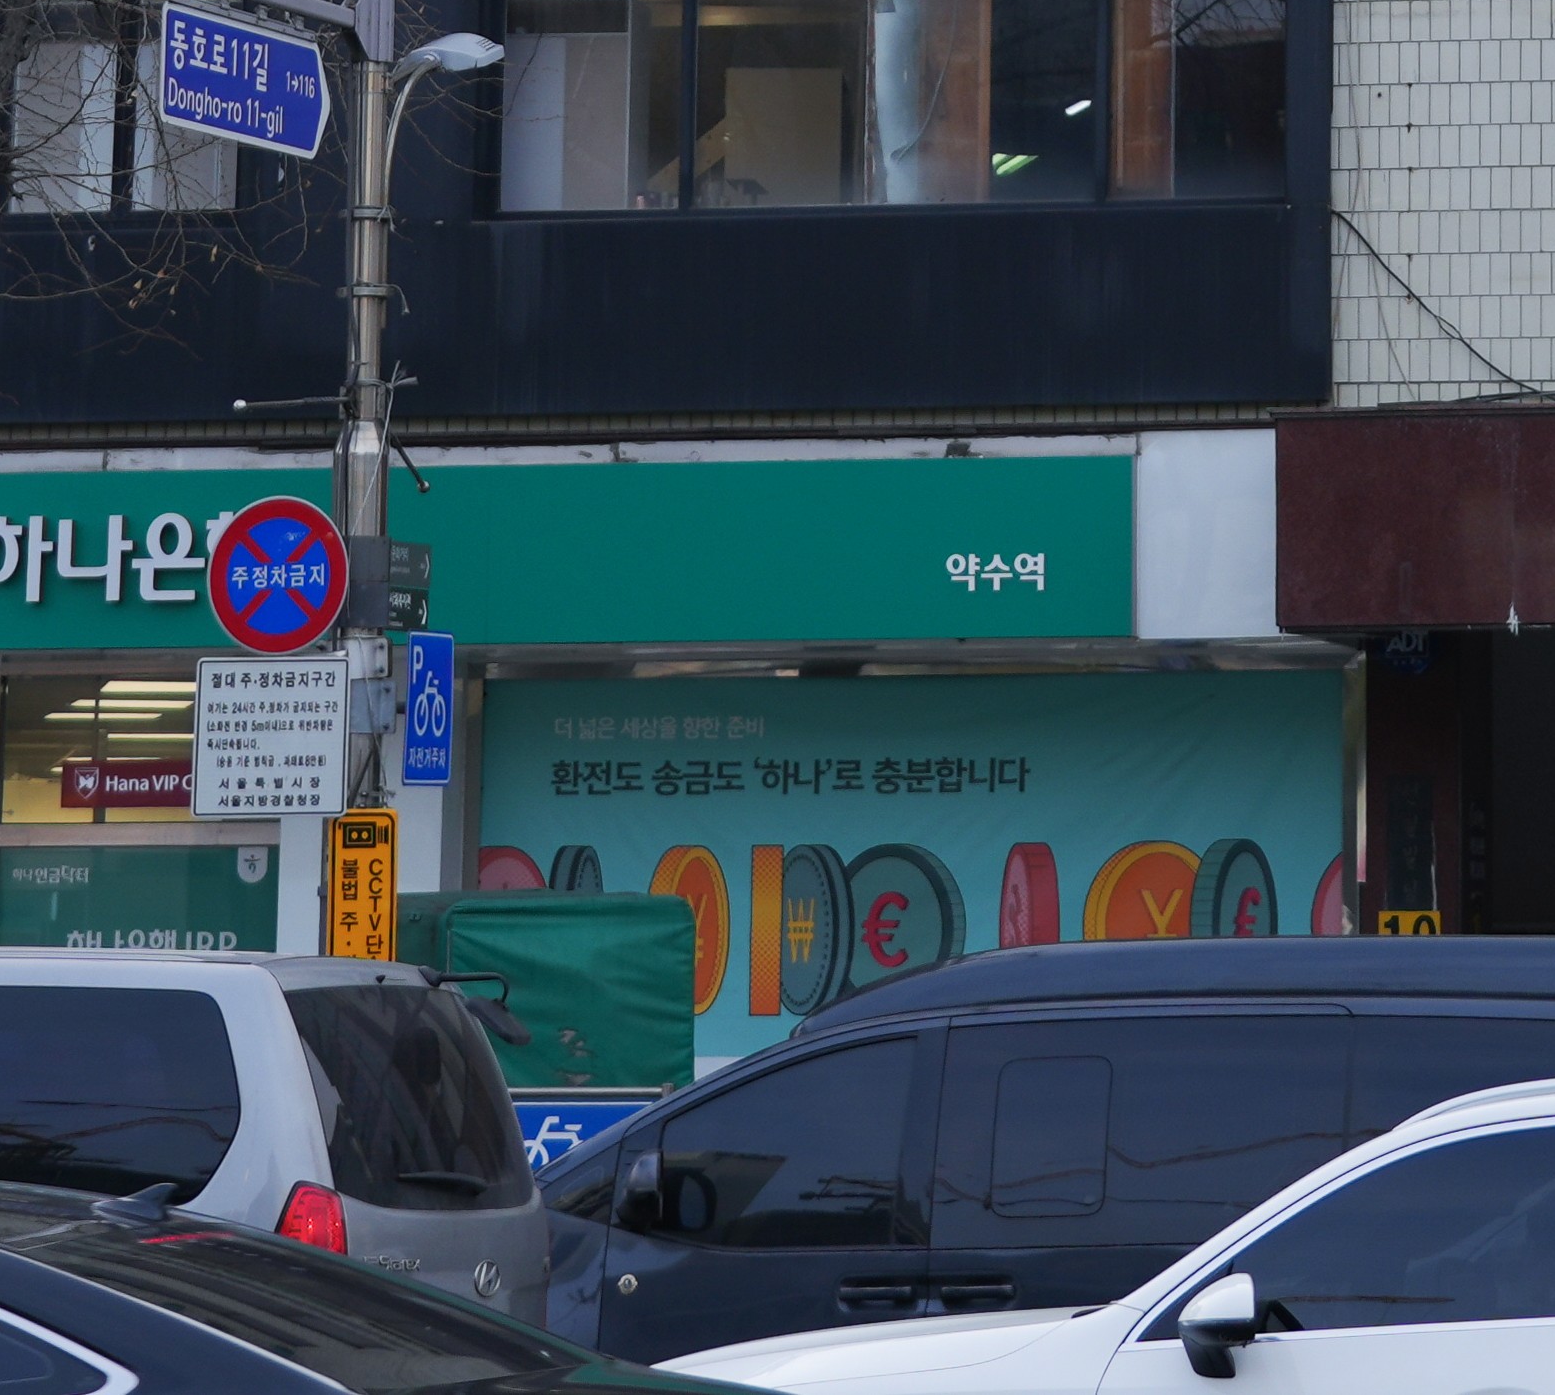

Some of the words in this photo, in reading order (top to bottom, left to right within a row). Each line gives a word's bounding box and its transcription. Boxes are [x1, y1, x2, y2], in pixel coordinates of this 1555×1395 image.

[170, 19, 269, 93] 동호로11길
[168, 77, 242, 124] Dongho-ro
[247, 99, 284, 139] 11-gil
[231, 563, 326, 589] 주정차금지
[945, 551, 1047, 593] 약수역
[413, 645, 423, 685] P
[212, 672, 236, 689] 절대
[207, 702, 229, 714] 여기는
[232, 702, 256, 714] 24시간
[324, 700, 338, 713] 구간
[554, 717, 574, 739] 더
[578, 715, 616, 740] 넓은
[621, 715, 677, 740] 세상을
[683, 715, 723, 740] 향한
[727, 715, 765, 740] 준비
[408, 747, 447, 769] 자전거주차
[105, 774, 150, 793] Hana
[152, 774, 181, 792] VIP
[551, 758, 644, 796] 환전도
[651, 758, 745, 796] 송금도
[871, 755, 1031, 795] 충분합니다
[218, 794, 321, 807] 서울지방경찰청장
[35, 864, 90, 884] 연금닥터
